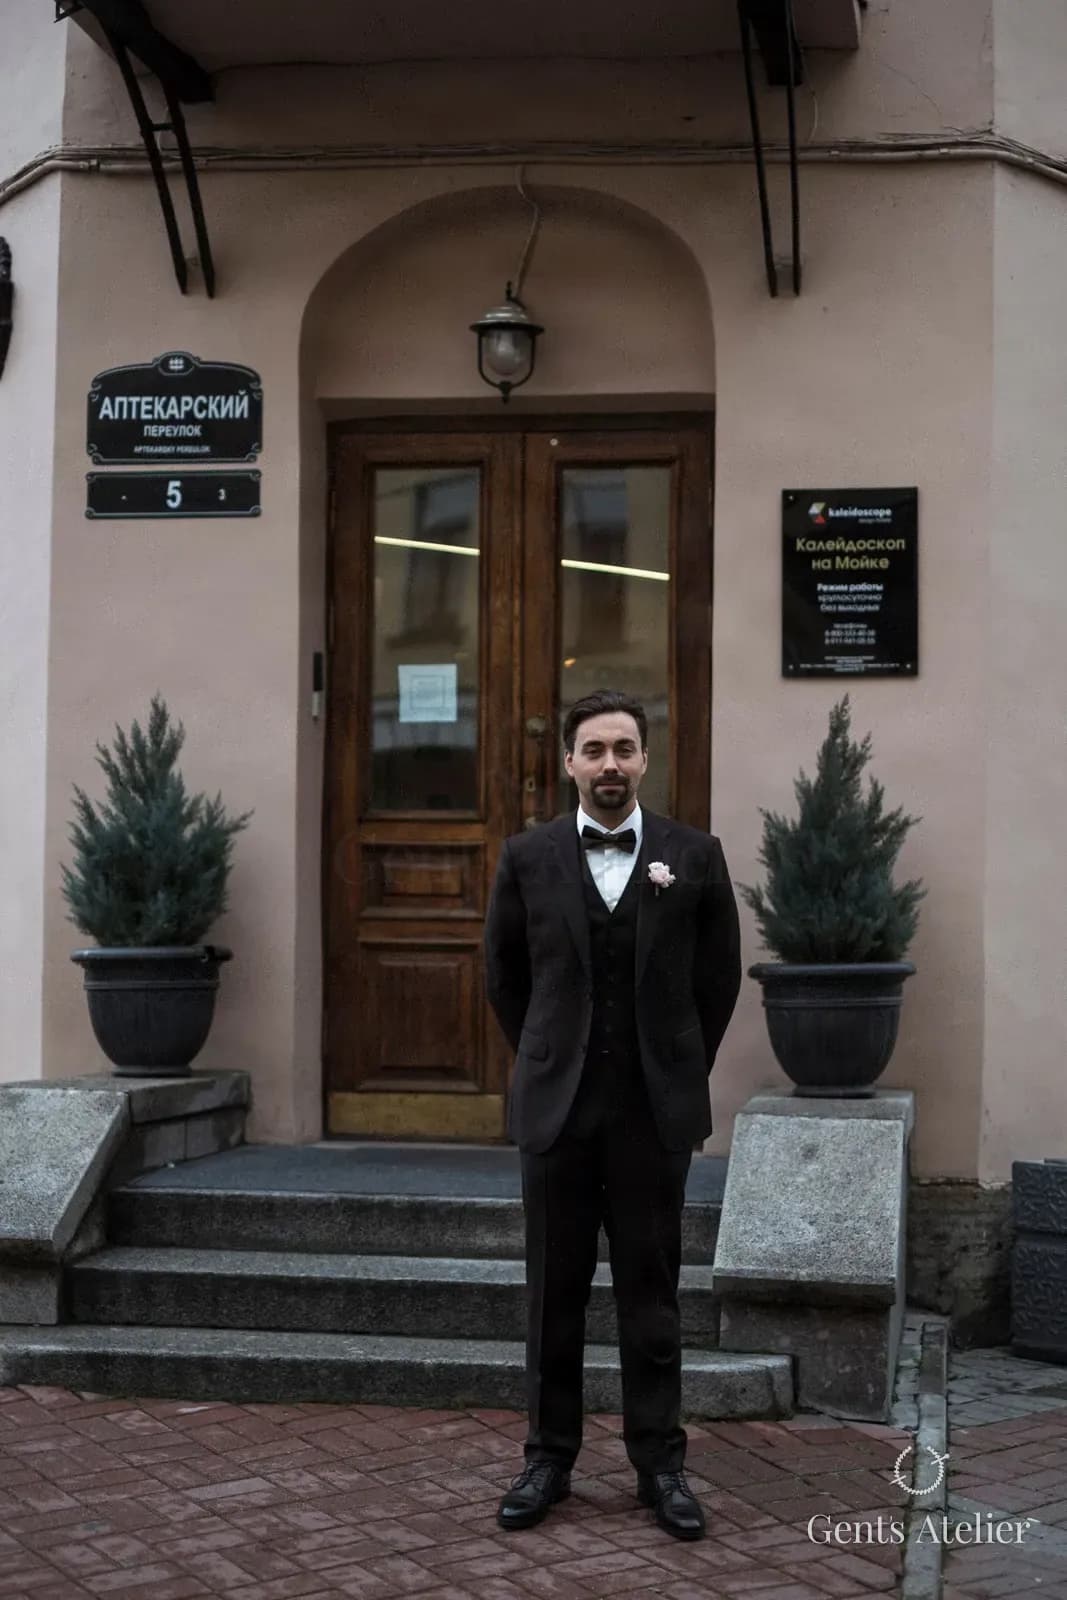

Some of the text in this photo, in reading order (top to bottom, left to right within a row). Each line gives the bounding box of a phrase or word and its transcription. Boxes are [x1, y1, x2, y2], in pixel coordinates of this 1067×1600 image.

[99, 389, 250, 420] АПТЕКАРСКИЙ
[143, 424, 203, 437] ПЕРЕУЛОК
[166, 480, 183, 509] 5
[828, 506, 892, 518] kaleidoscope
[795, 537, 906, 553] Калейдоскоп
[811, 554, 890, 570] на Мойке
[849, 582, 884, 593] работы
